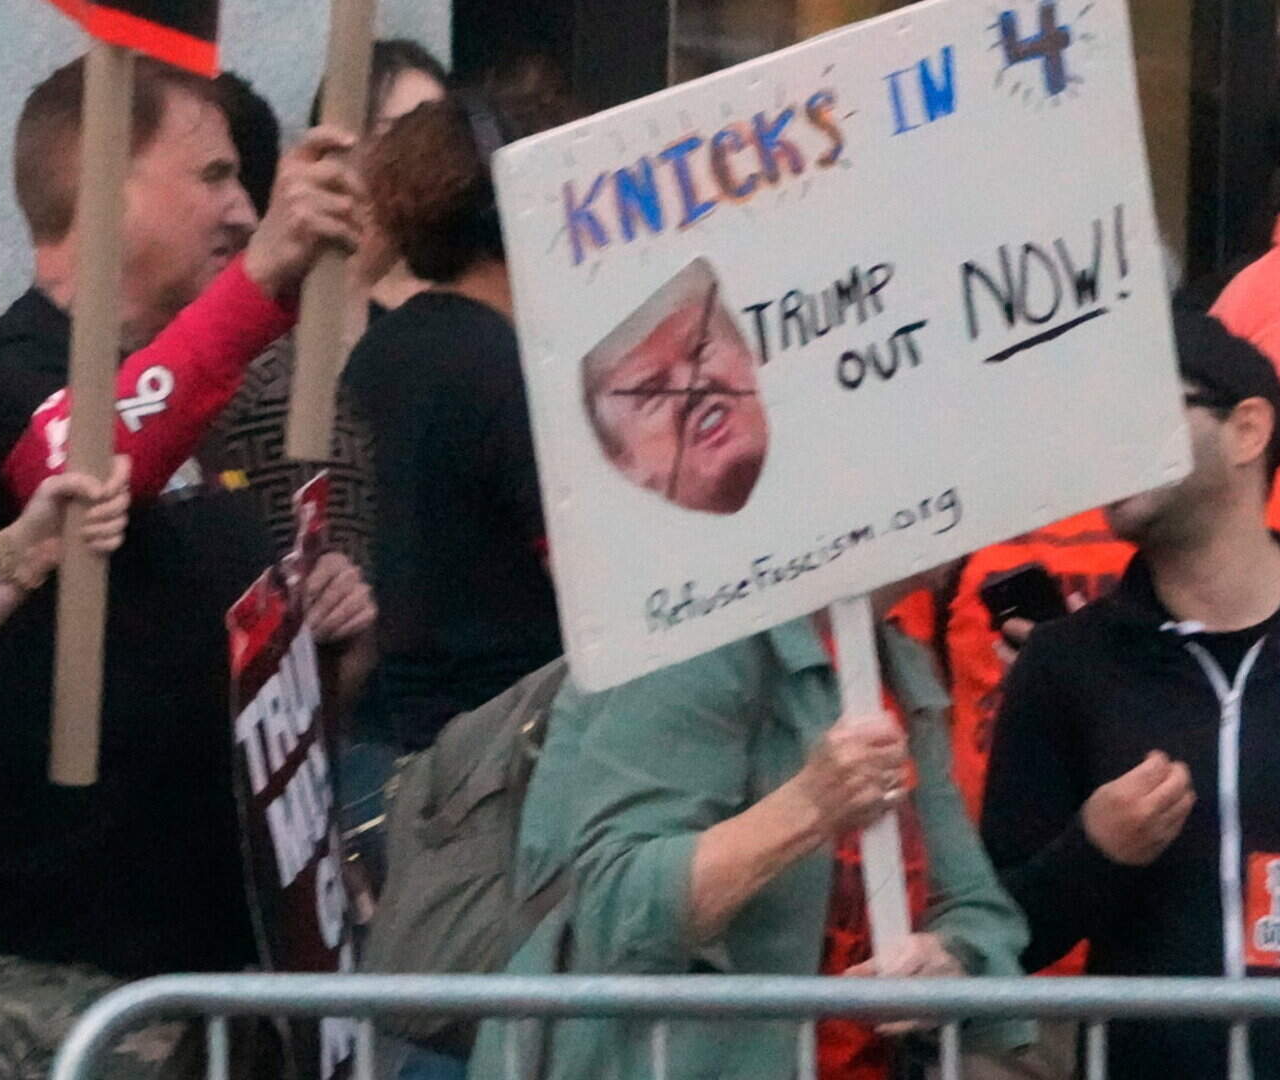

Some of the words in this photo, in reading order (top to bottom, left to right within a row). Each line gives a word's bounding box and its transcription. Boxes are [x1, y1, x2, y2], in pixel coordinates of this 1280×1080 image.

[562, 89, 845, 266] KNICKS
[885, 44, 958, 137] IN
[742, 261, 894, 367] TRUMP
[837, 320, 928, 390] OUT
[961, 203, 1131, 340] NOW!
